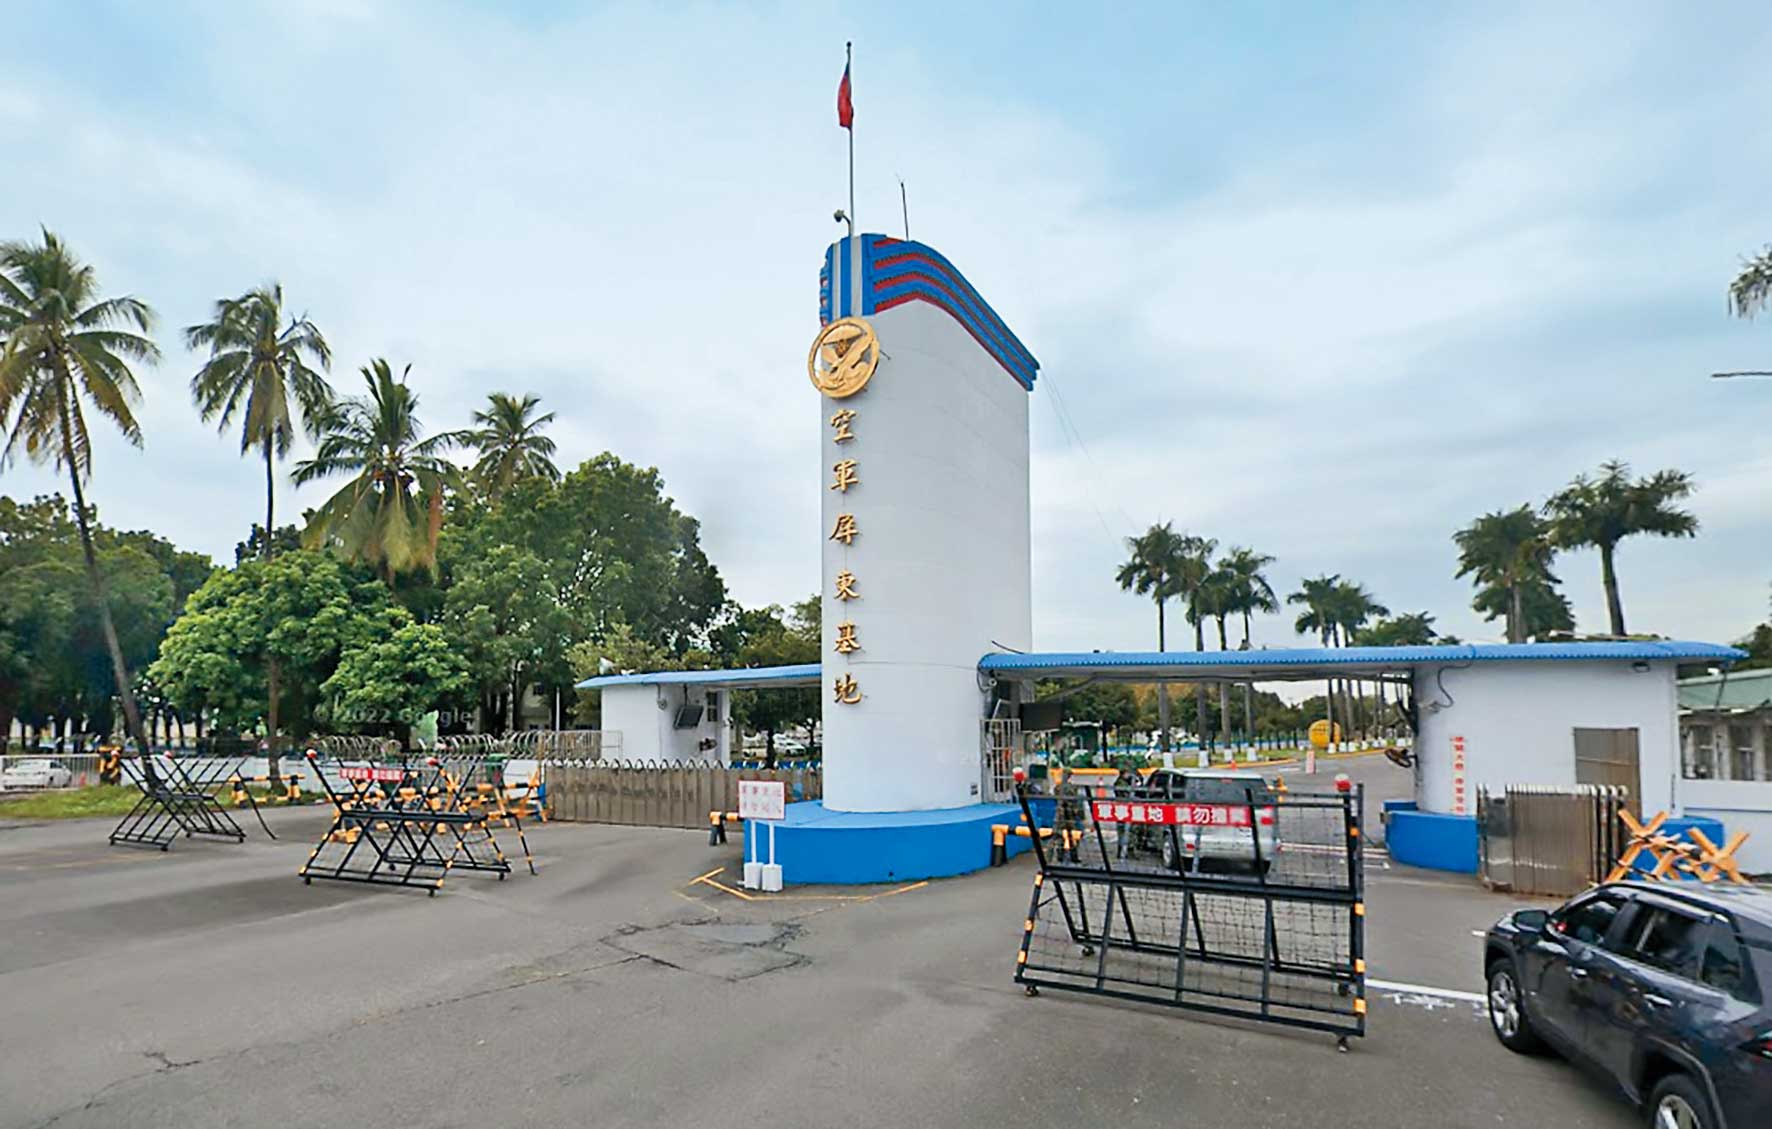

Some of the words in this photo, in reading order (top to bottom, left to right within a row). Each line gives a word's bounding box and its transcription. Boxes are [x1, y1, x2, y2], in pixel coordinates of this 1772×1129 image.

[829, 410, 862, 704] 空軍屏東基地
